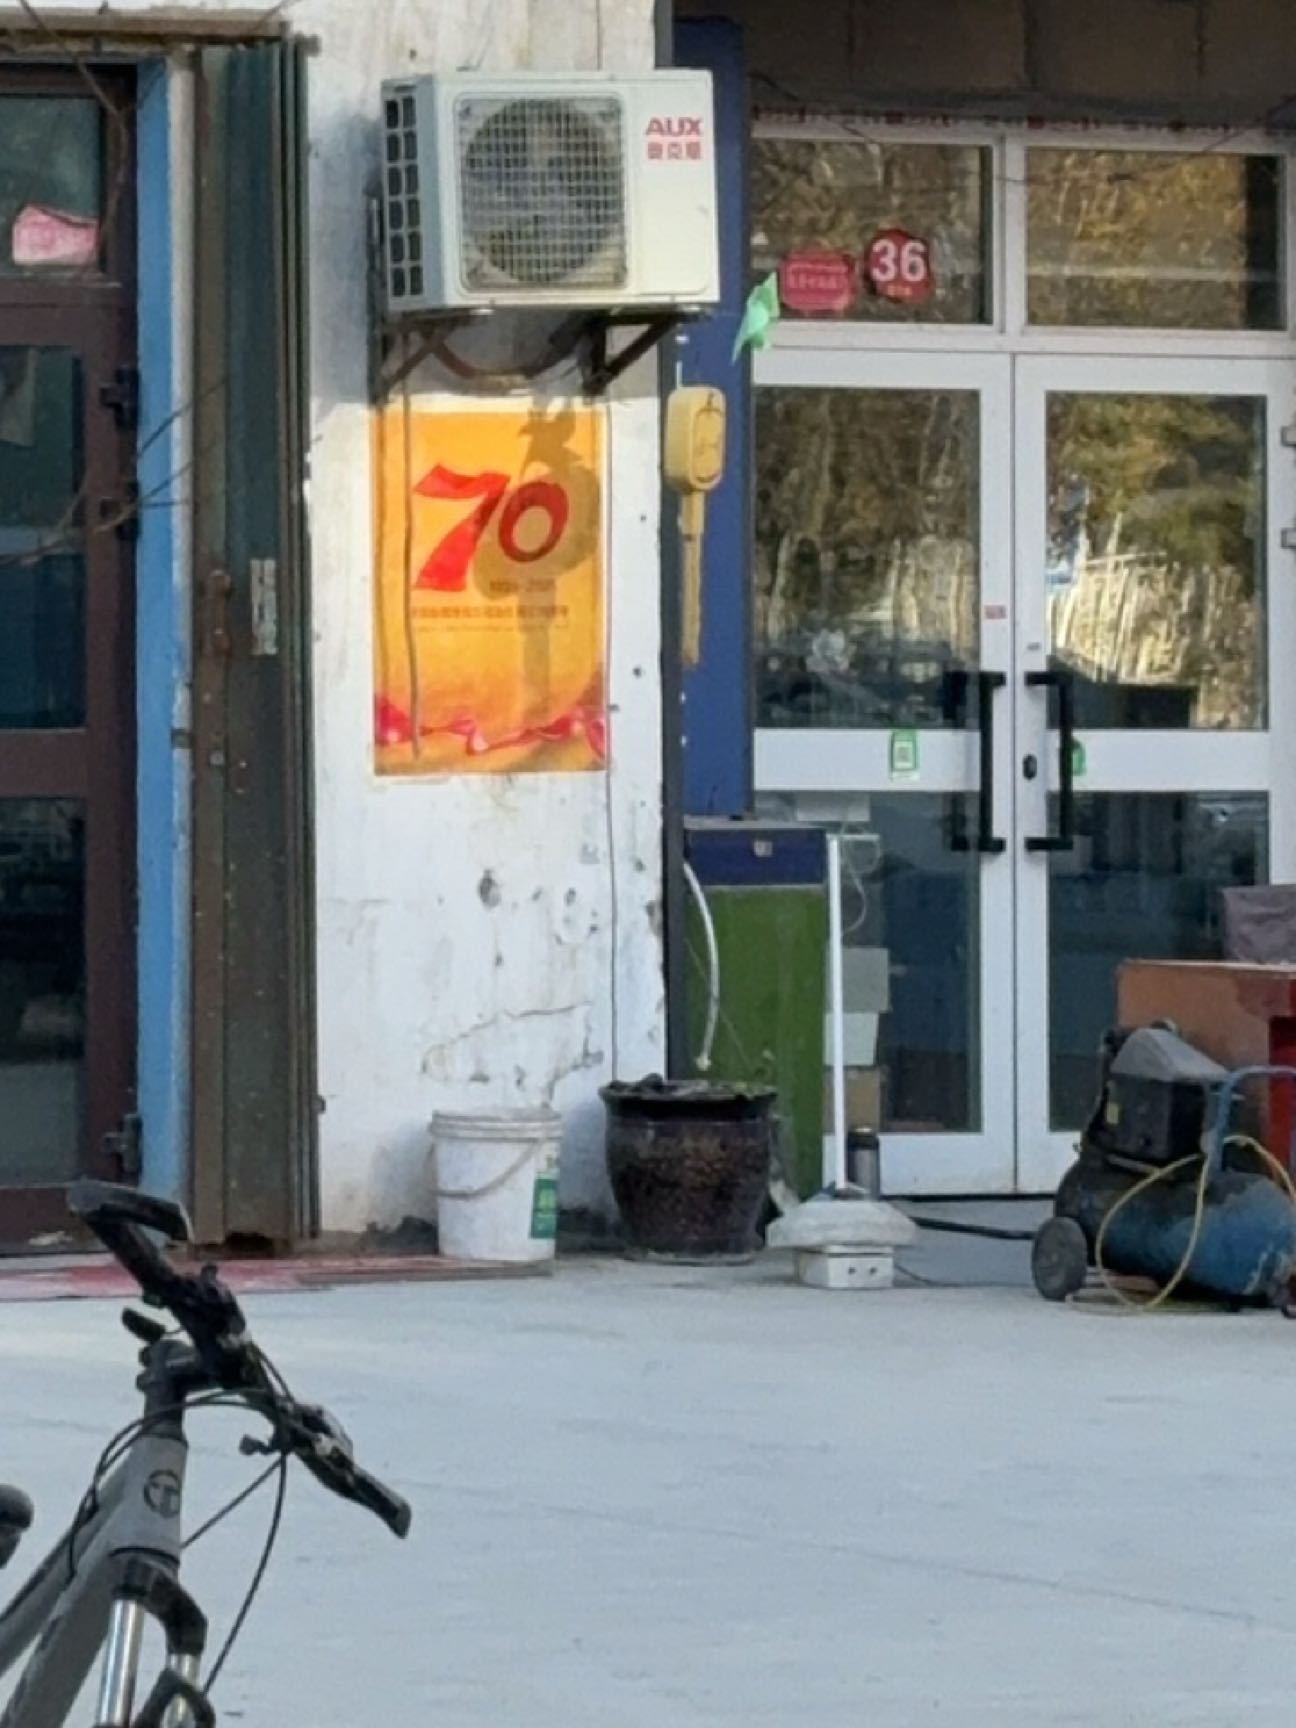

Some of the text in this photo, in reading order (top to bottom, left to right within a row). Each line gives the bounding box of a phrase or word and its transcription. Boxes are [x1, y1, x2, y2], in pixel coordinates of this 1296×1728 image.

[645, 117, 702, 138] AUX
[871, 239, 926, 282] 36
[413, 463, 568, 592] 70
